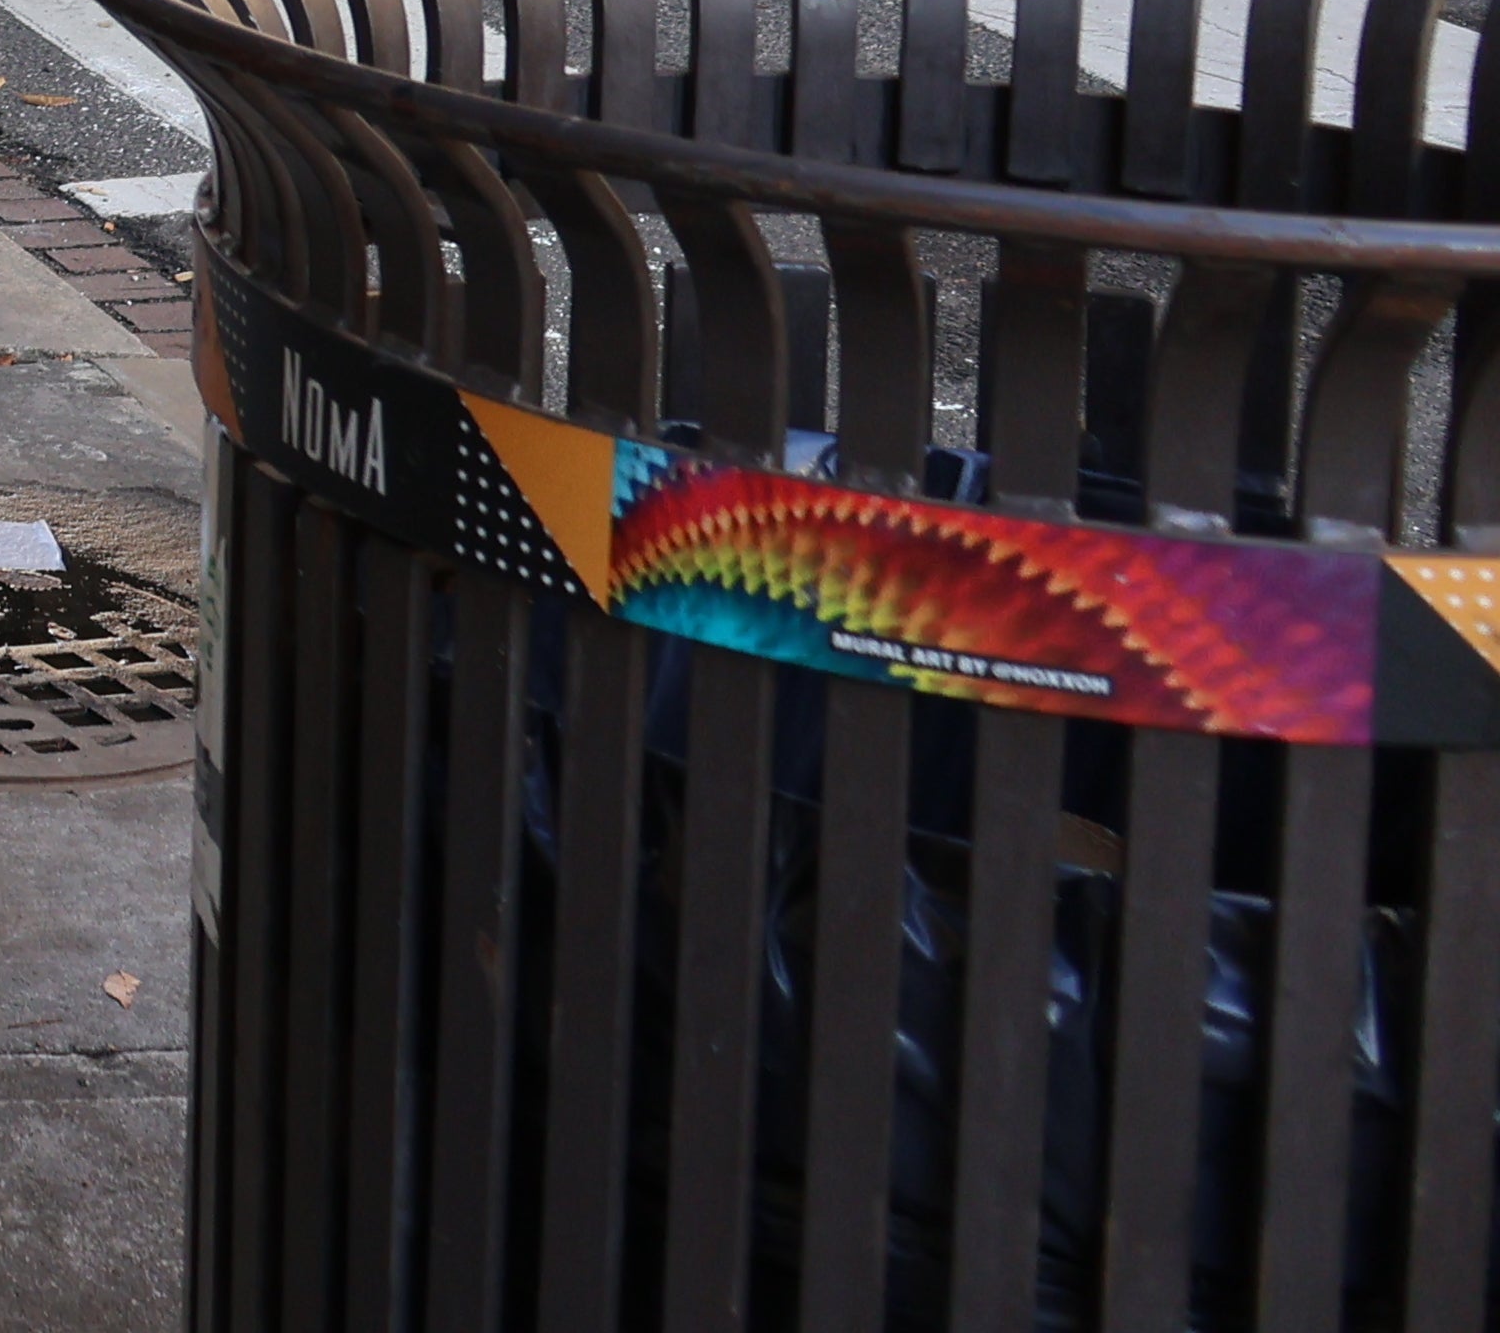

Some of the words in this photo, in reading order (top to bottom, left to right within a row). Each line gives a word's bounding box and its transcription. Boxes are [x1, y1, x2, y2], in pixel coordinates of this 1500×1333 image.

[832, 631, 906, 662] MURAL
[911, 645, 954, 670] ART
[957, 654, 988, 677] BY
